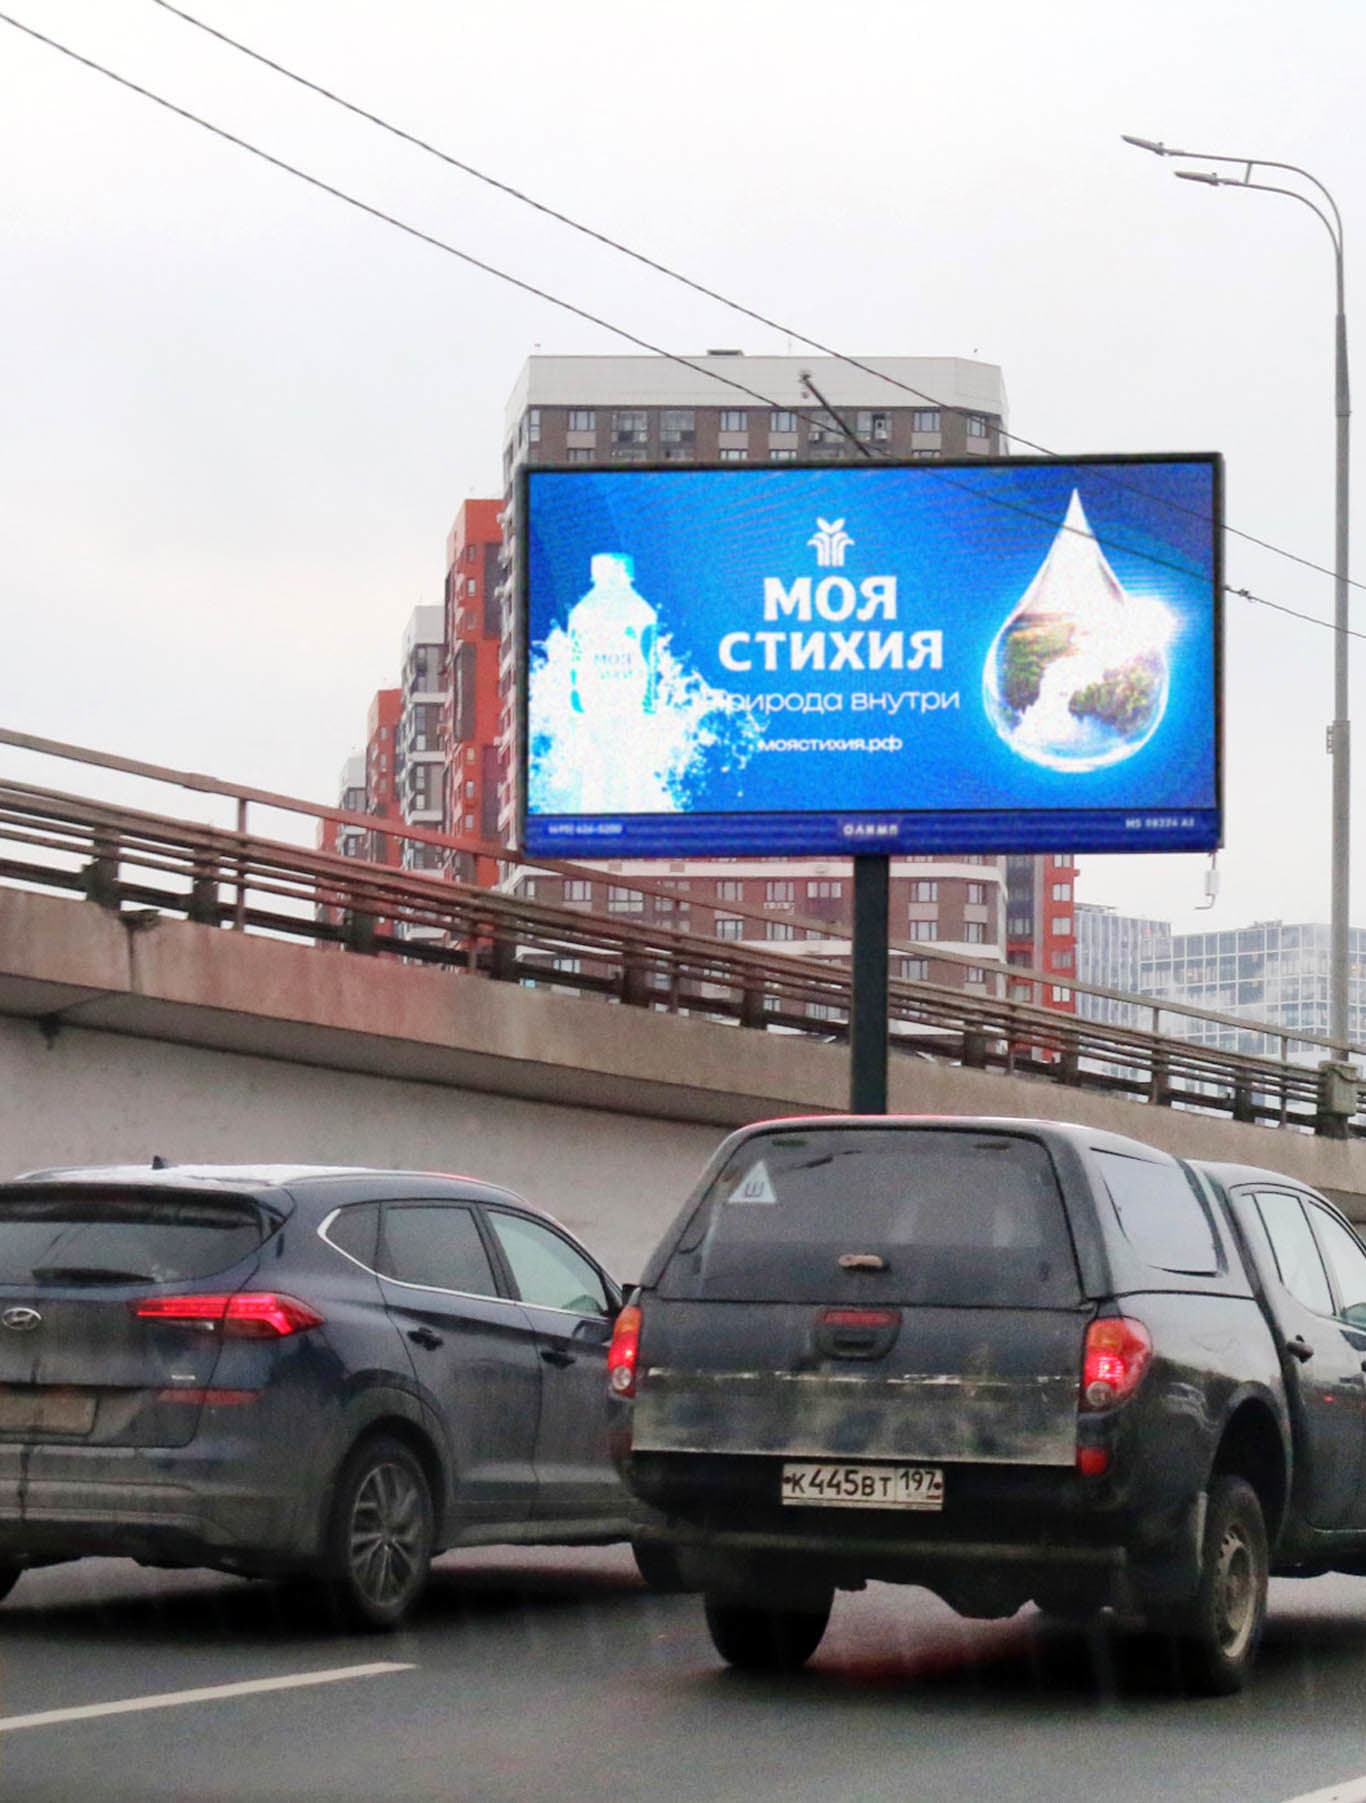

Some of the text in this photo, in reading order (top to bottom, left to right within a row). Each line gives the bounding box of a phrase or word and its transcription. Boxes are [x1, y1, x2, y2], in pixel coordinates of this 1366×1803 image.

[763, 575, 898, 622] МОЯ
[718, 629, 944, 672] СТИХИЯ
[712, 690, 961, 715] рирода внутри
